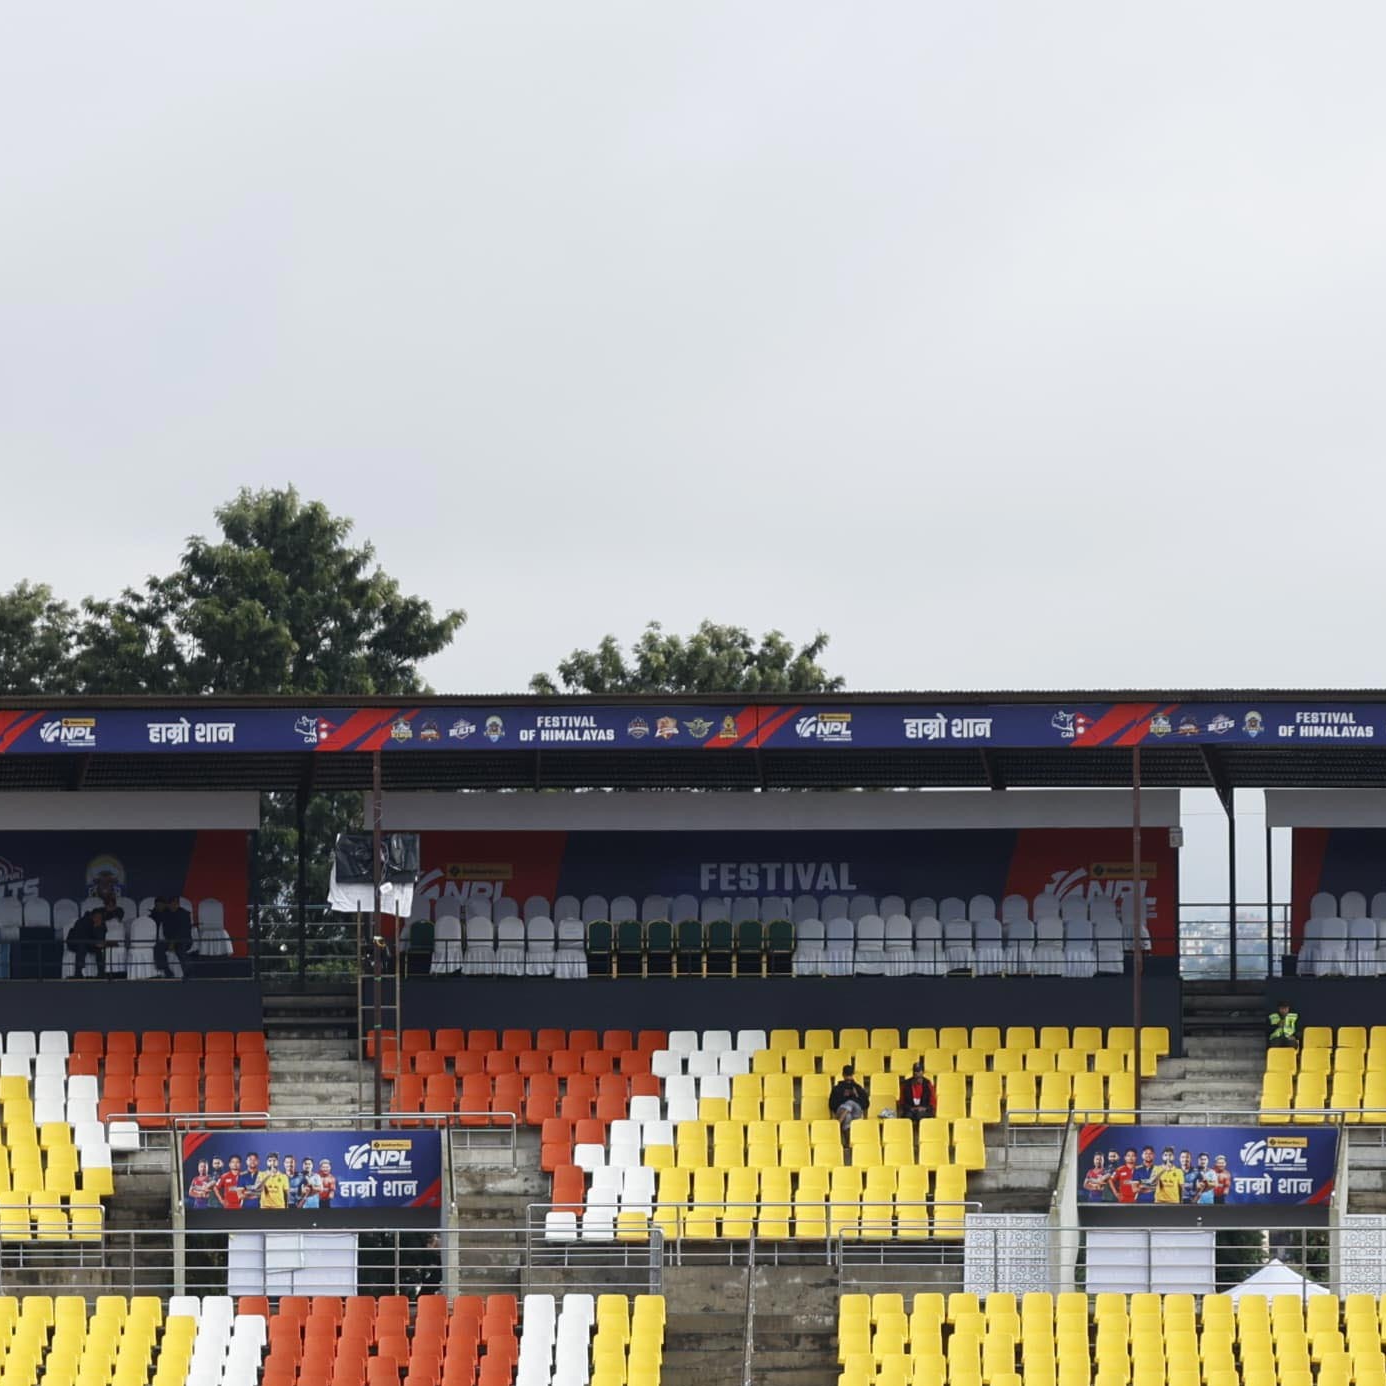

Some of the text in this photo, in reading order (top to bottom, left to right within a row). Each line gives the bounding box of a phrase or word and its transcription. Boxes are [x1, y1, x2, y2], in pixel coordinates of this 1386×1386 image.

[537, 716, 597, 727] FESTIVAL
[1296, 712, 1356, 724] FESTIVAL
[60, 727, 95, 740] NPL
[148, 716, 236, 745] हाम्रो शान
[520, 729, 615, 741] OF HIMALAYAS
[816, 722, 852, 739] NPL
[904, 713, 992, 741] हाम्रो शान
[1279, 725, 1374, 738] OF HIMALAYAS
[700, 863, 857, 891] FESTIVAL
[368, 1151, 412, 1167] NPL
[1264, 1148, 1308, 1164] NPL
[338, 1177, 418, 1199] हाम्रो शान
[1234, 1174, 1313, 1196] हाम्रो शान
